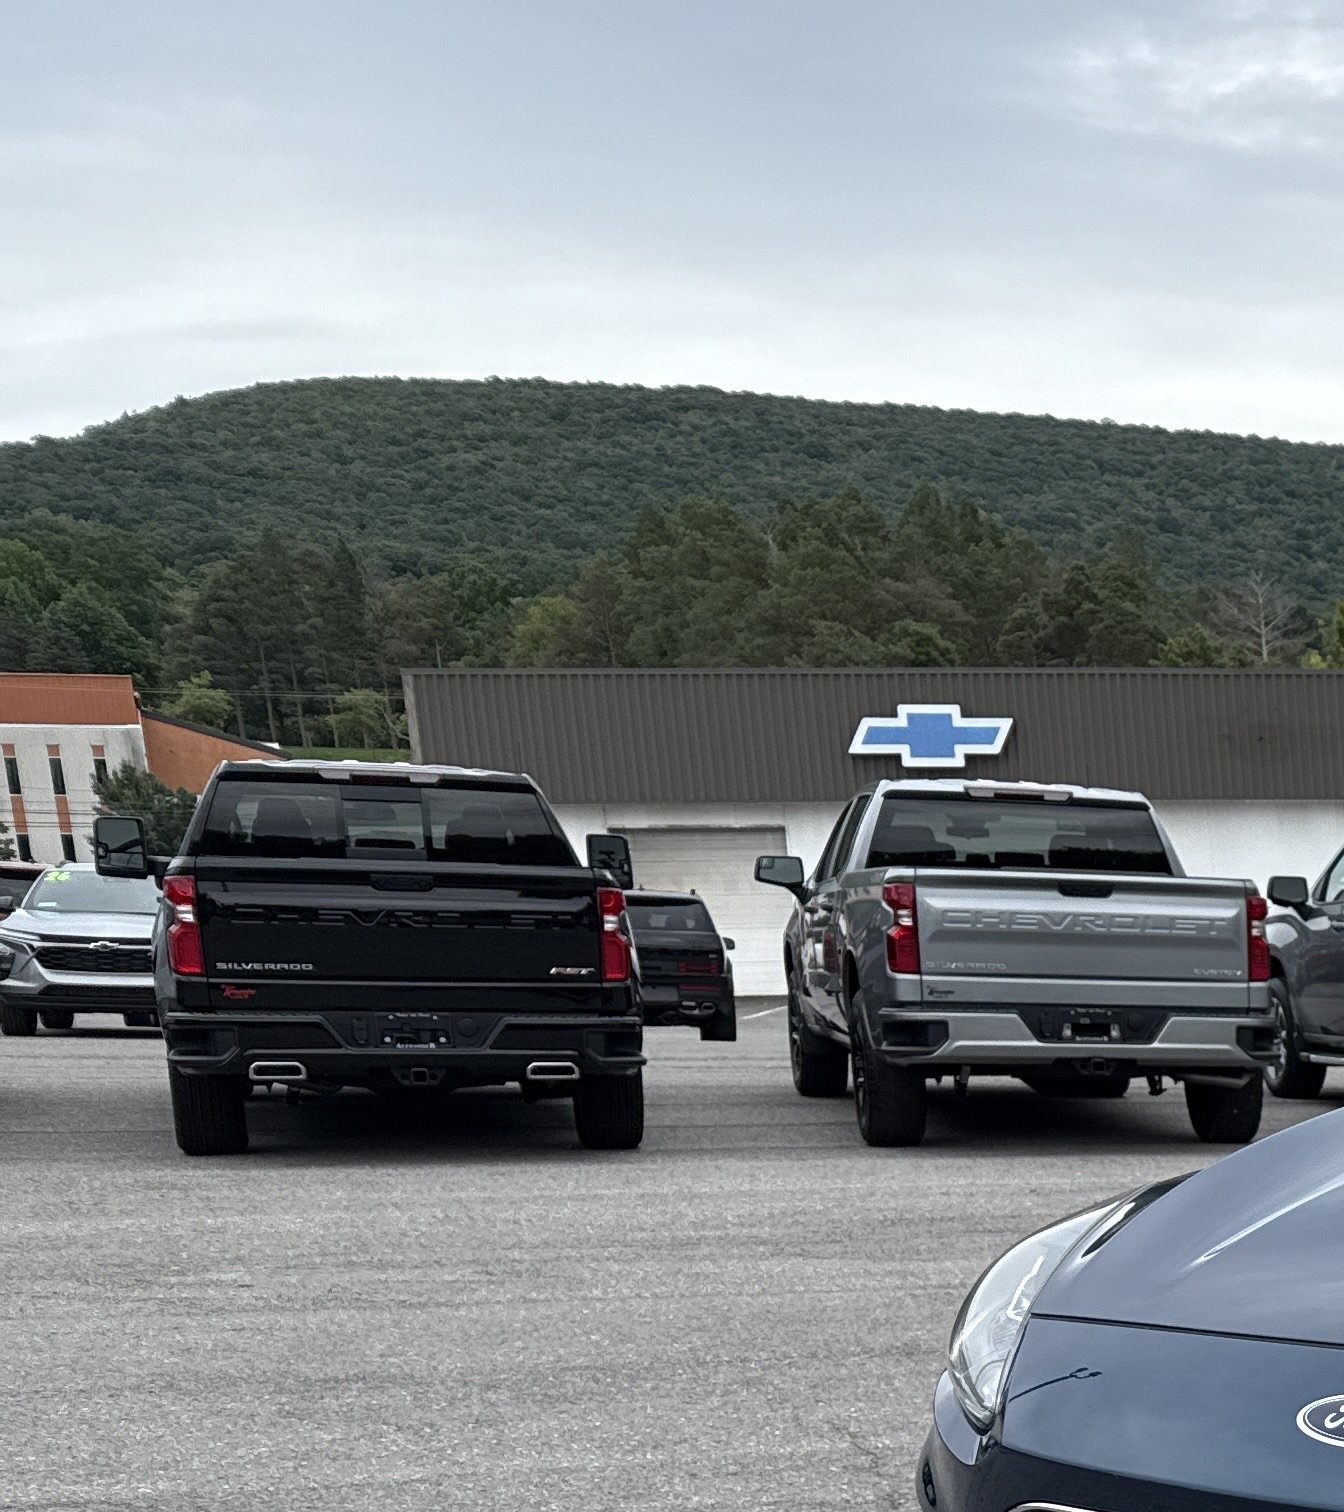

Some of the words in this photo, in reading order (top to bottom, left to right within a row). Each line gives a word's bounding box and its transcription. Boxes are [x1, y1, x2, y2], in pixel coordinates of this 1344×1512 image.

[942, 910, 1228, 936] CHEVROLET
[215, 962, 313, 971] SILVERADO
[925, 960, 1007, 971] SILVERADO
